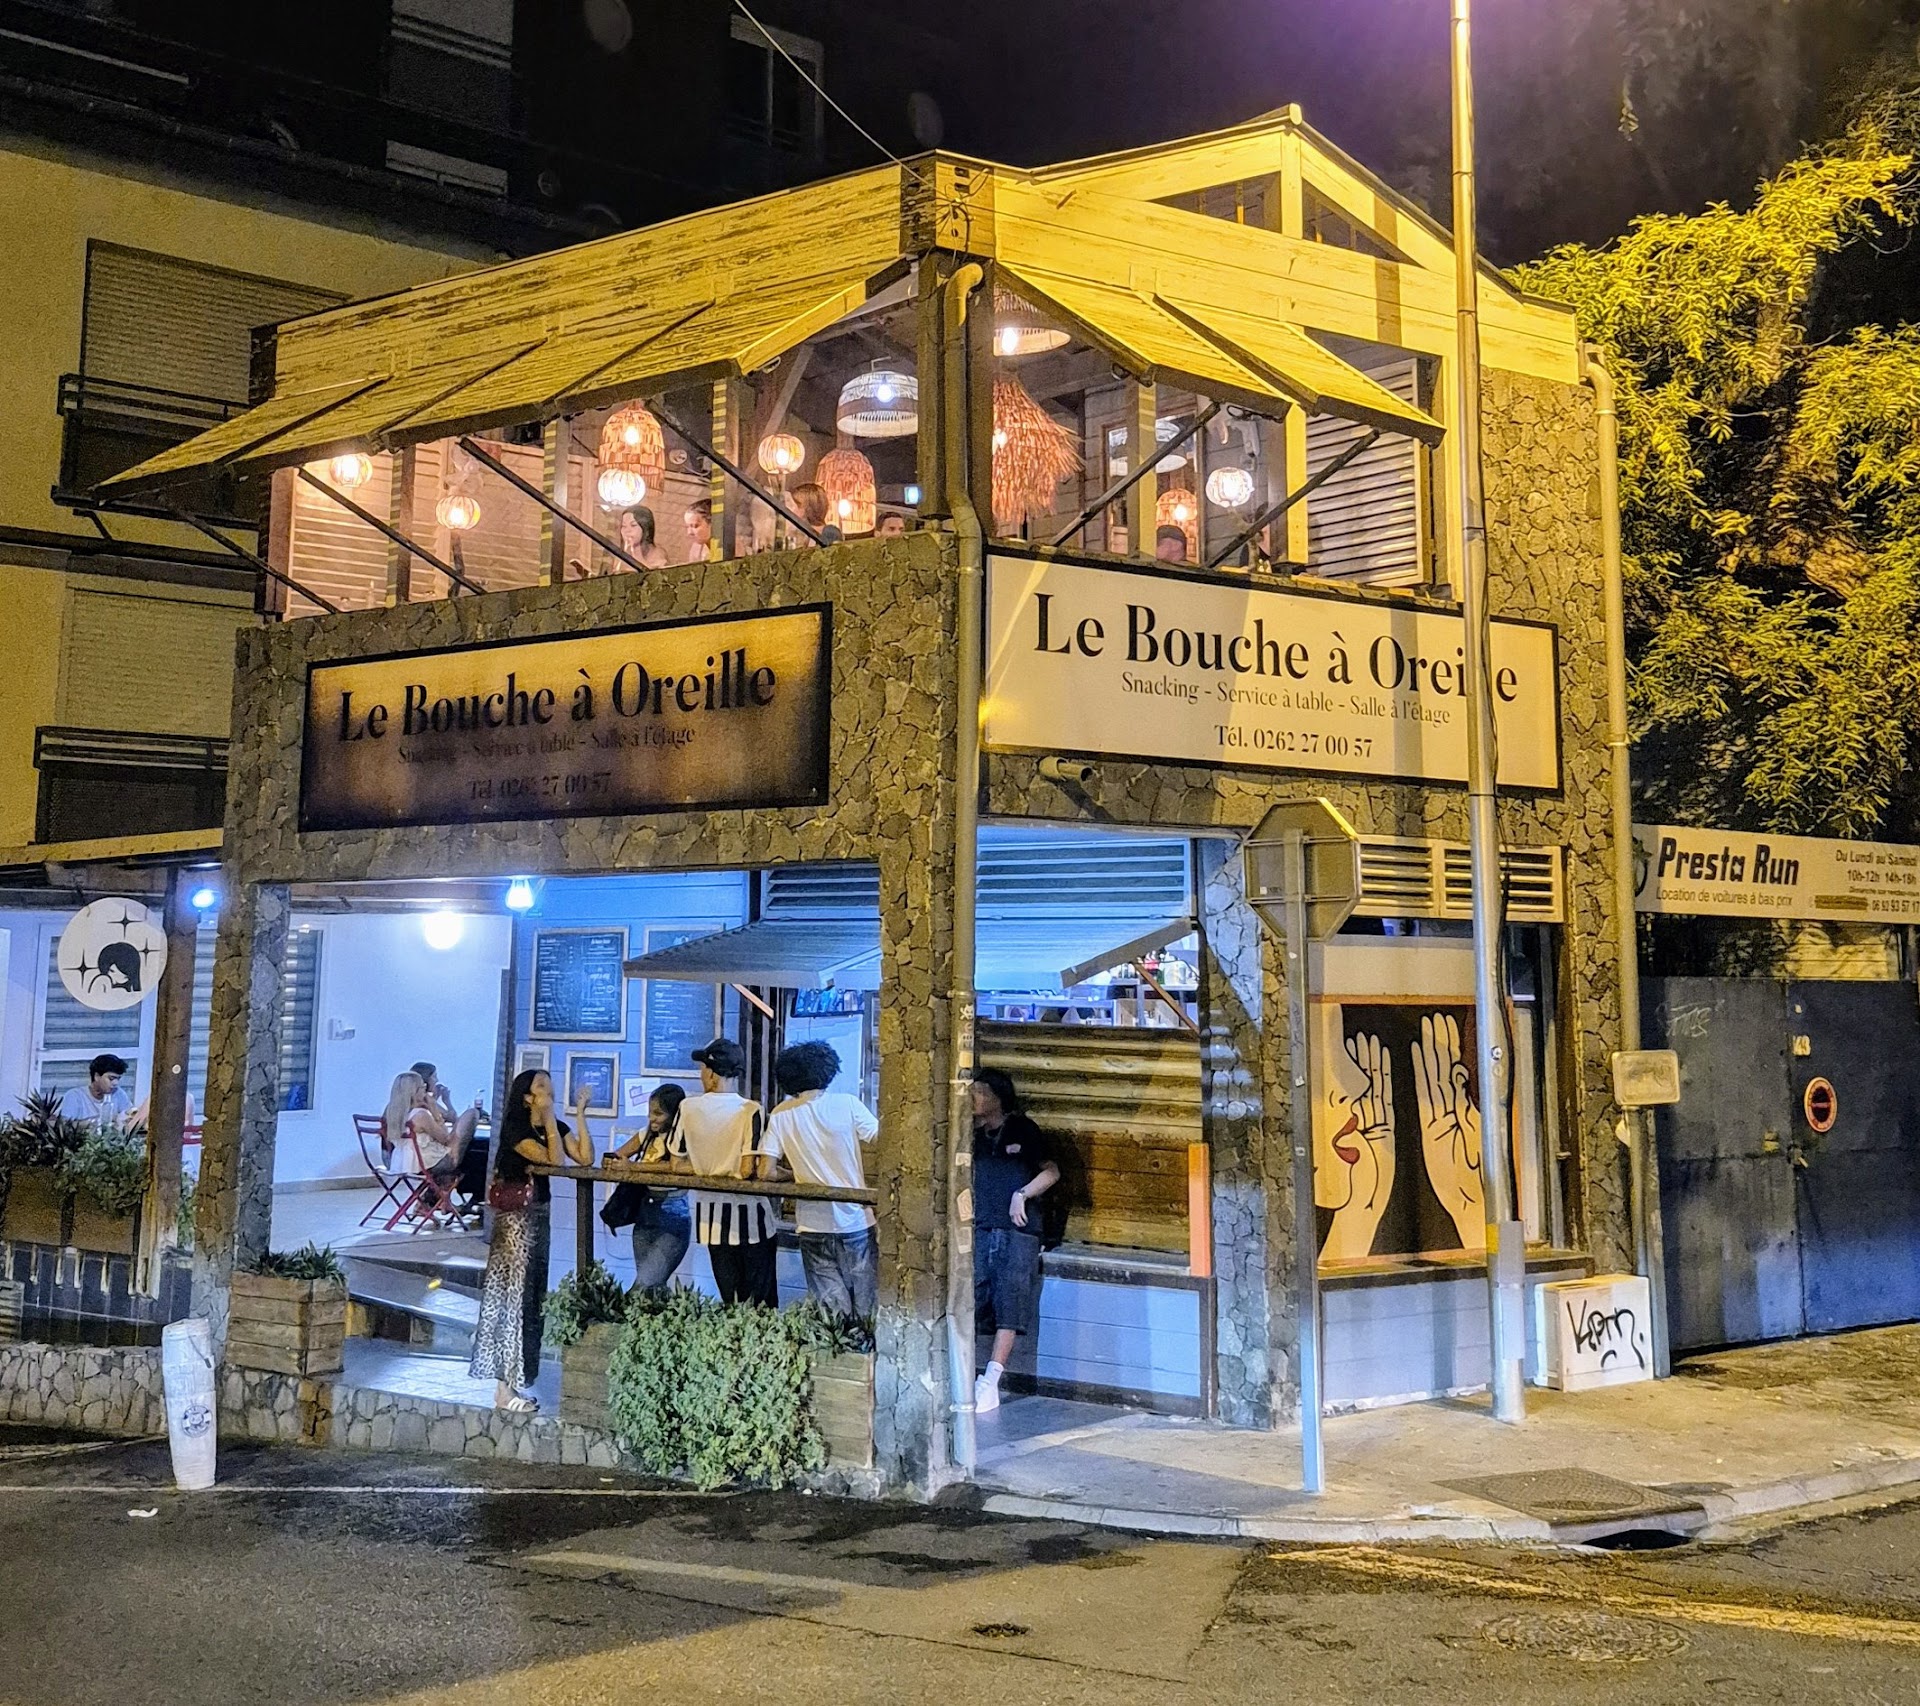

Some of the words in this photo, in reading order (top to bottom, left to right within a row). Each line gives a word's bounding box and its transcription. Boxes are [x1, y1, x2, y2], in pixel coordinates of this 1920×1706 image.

[1033, 591, 1106, 658] Le
[1125, 603, 1310, 680] Bouche
[1327, 630, 1354, 685] à
[1369, 635, 1518, 702] Oreie
[338, 690, 389, 743] Le
[402, 673, 556, 737] Bouche
[571, 667, 597, 722] à
[611, 646, 777, 719] Oreille
[1121, 671, 1200, 705] Snacking
[1217, 680, 1278, 707] Service
[1282, 688, 1291, 708] à
[1296, 690, 1334, 713] table
[1350, 695, 1386, 717] Salle
[1390, 700, 1399, 719] à
[1403, 700, 1451, 729] l'étage
[1214, 724, 1249, 748] Tél.
[1253, 728, 1295, 752] 0262
[1301, 732, 1320, 754] 27
[1325, 734, 1349, 757] 00
[1354, 737, 1373, 758] 57
[1657, 837, 1746, 882] Presta
[1752, 844, 1800, 885] Run
[1655, 887, 1696, 901] Location
[1697, 888, 1710, 902] de
[1712, 889, 1748, 904] voitures
[1757, 891, 1774, 906] bas
